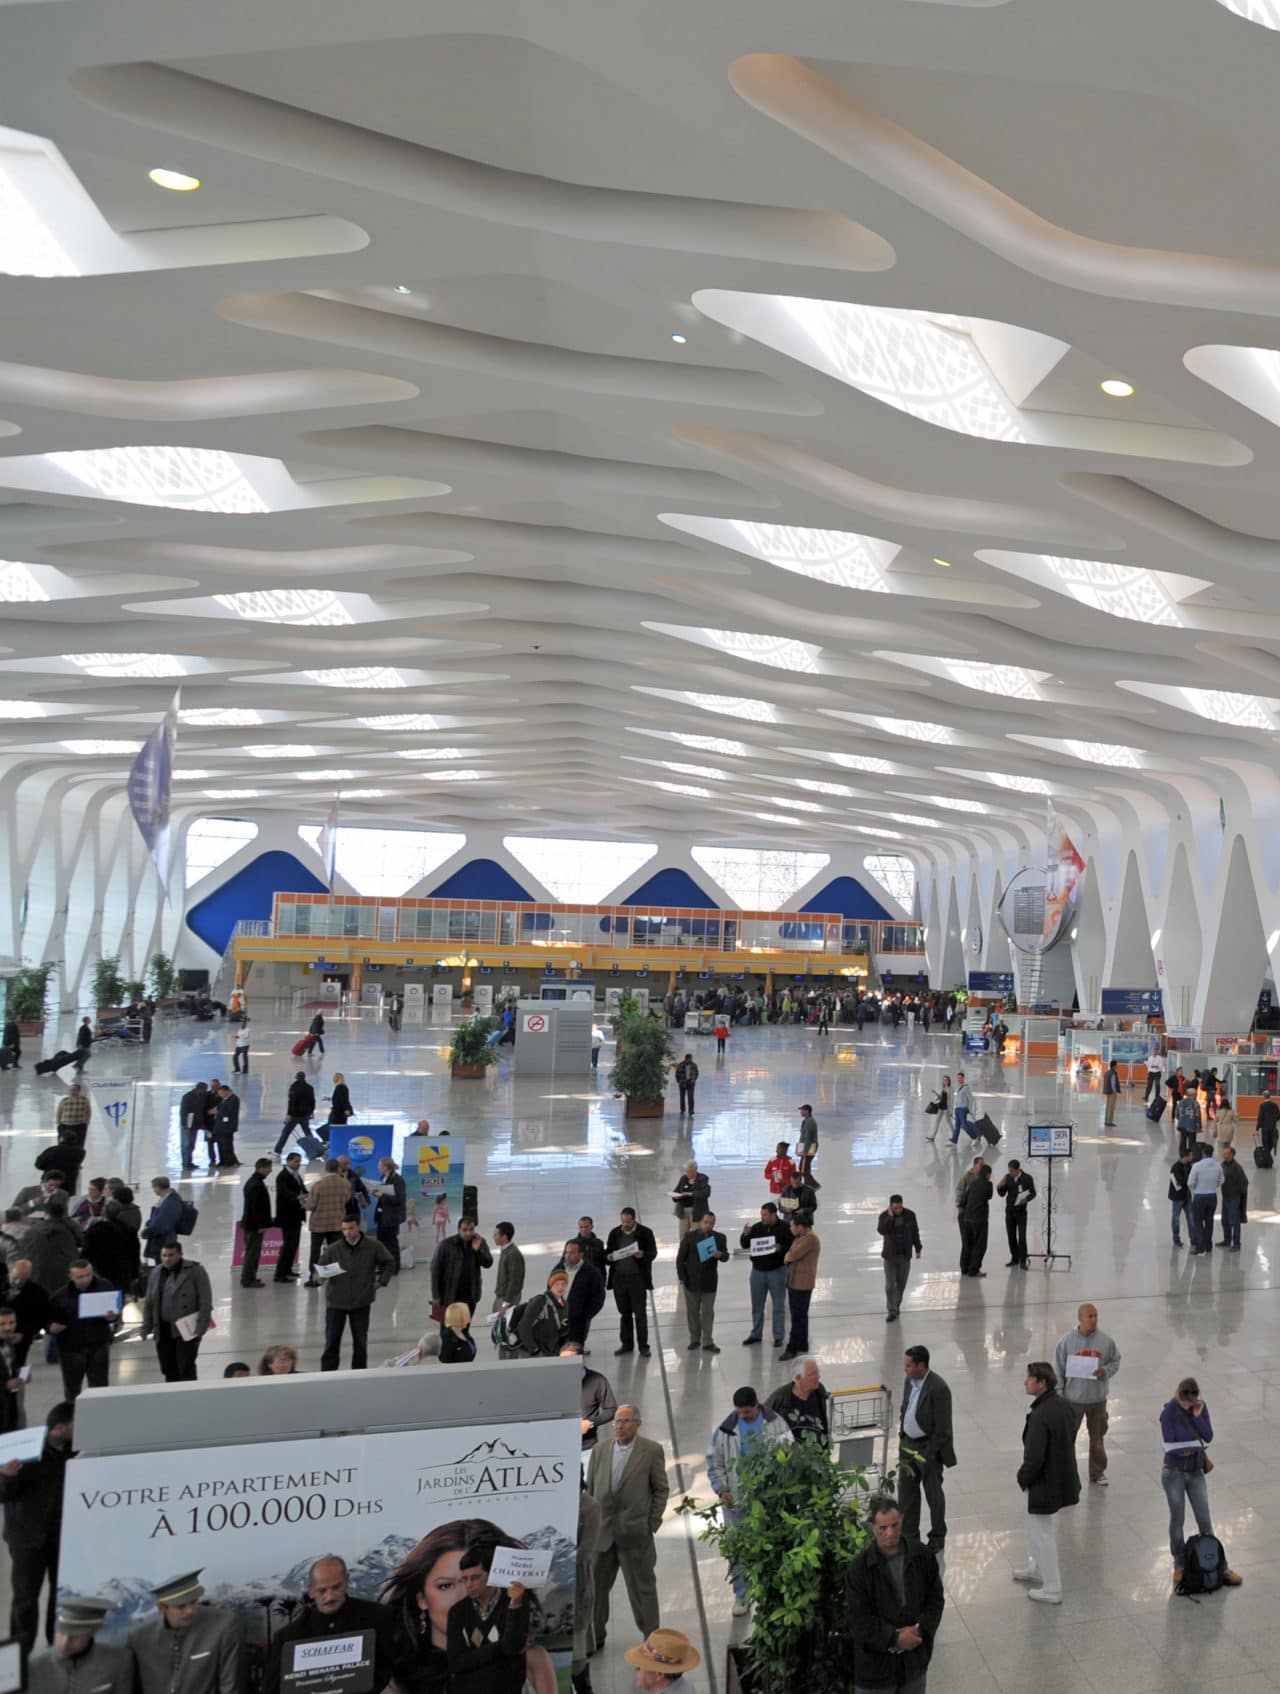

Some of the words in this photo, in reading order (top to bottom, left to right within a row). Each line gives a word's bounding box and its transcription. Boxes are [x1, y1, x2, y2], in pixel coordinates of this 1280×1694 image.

[80, 1486, 170, 1510] VOTRE
[179, 1467, 358, 1501] APPARTEMENT
[417, 1474, 475, 1495] JARDINS
[474, 1462, 565, 1493] ATLAS
[149, 1508, 176, 1539] À
[187, 1493, 326, 1533] 100.000
